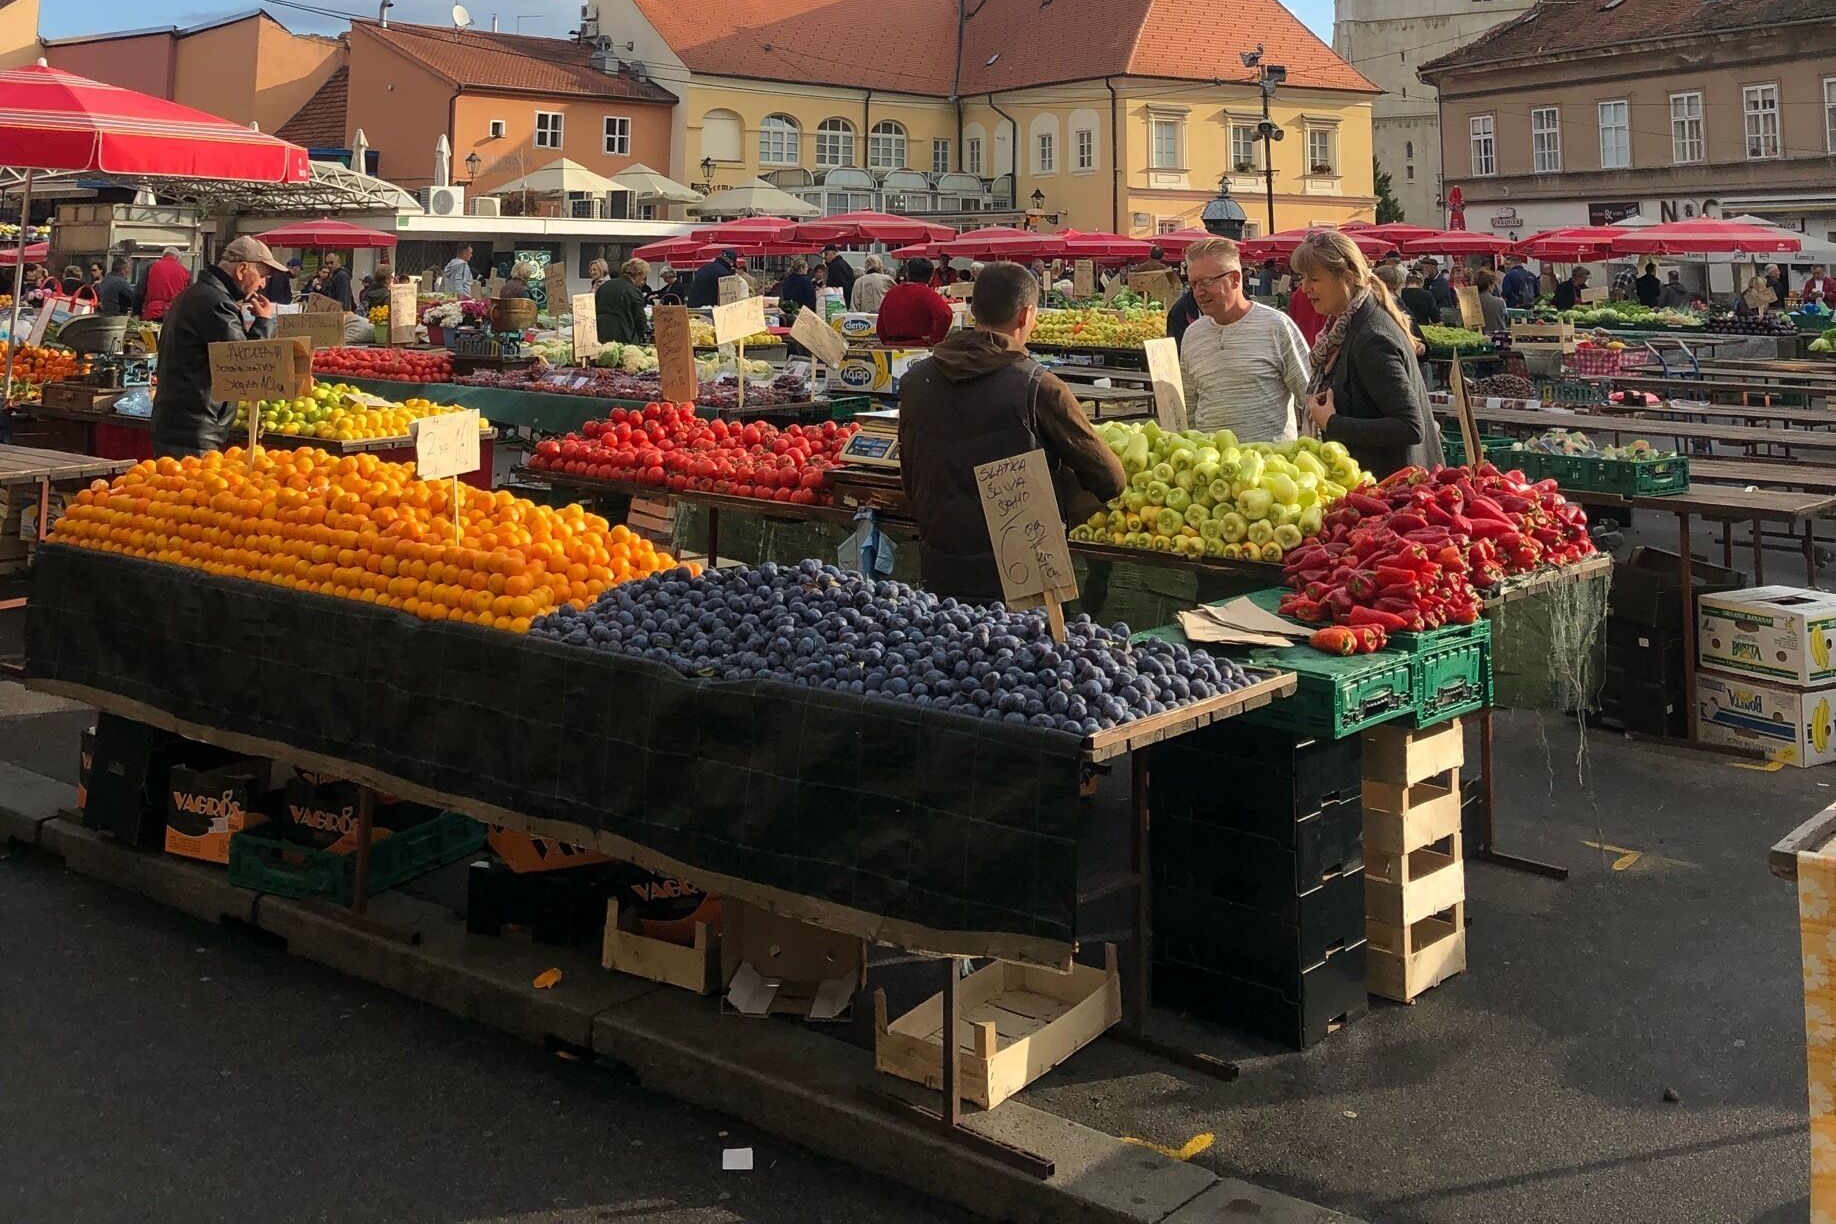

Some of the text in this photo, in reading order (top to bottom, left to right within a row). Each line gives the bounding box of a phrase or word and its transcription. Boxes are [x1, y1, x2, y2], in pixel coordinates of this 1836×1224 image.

[844, 321, 870, 331] derby
[842, 367, 870, 385] derby
[978, 458, 1027, 482] SLATKA
[998, 491, 1031, 517] SAMO
[1722, 610, 1773, 624] ORGANIC BANANAS
[1731, 640, 1762, 661] BONITA
[1727, 688, 1763, 713] BONITA
[173, 790, 241, 818] VAGROS
